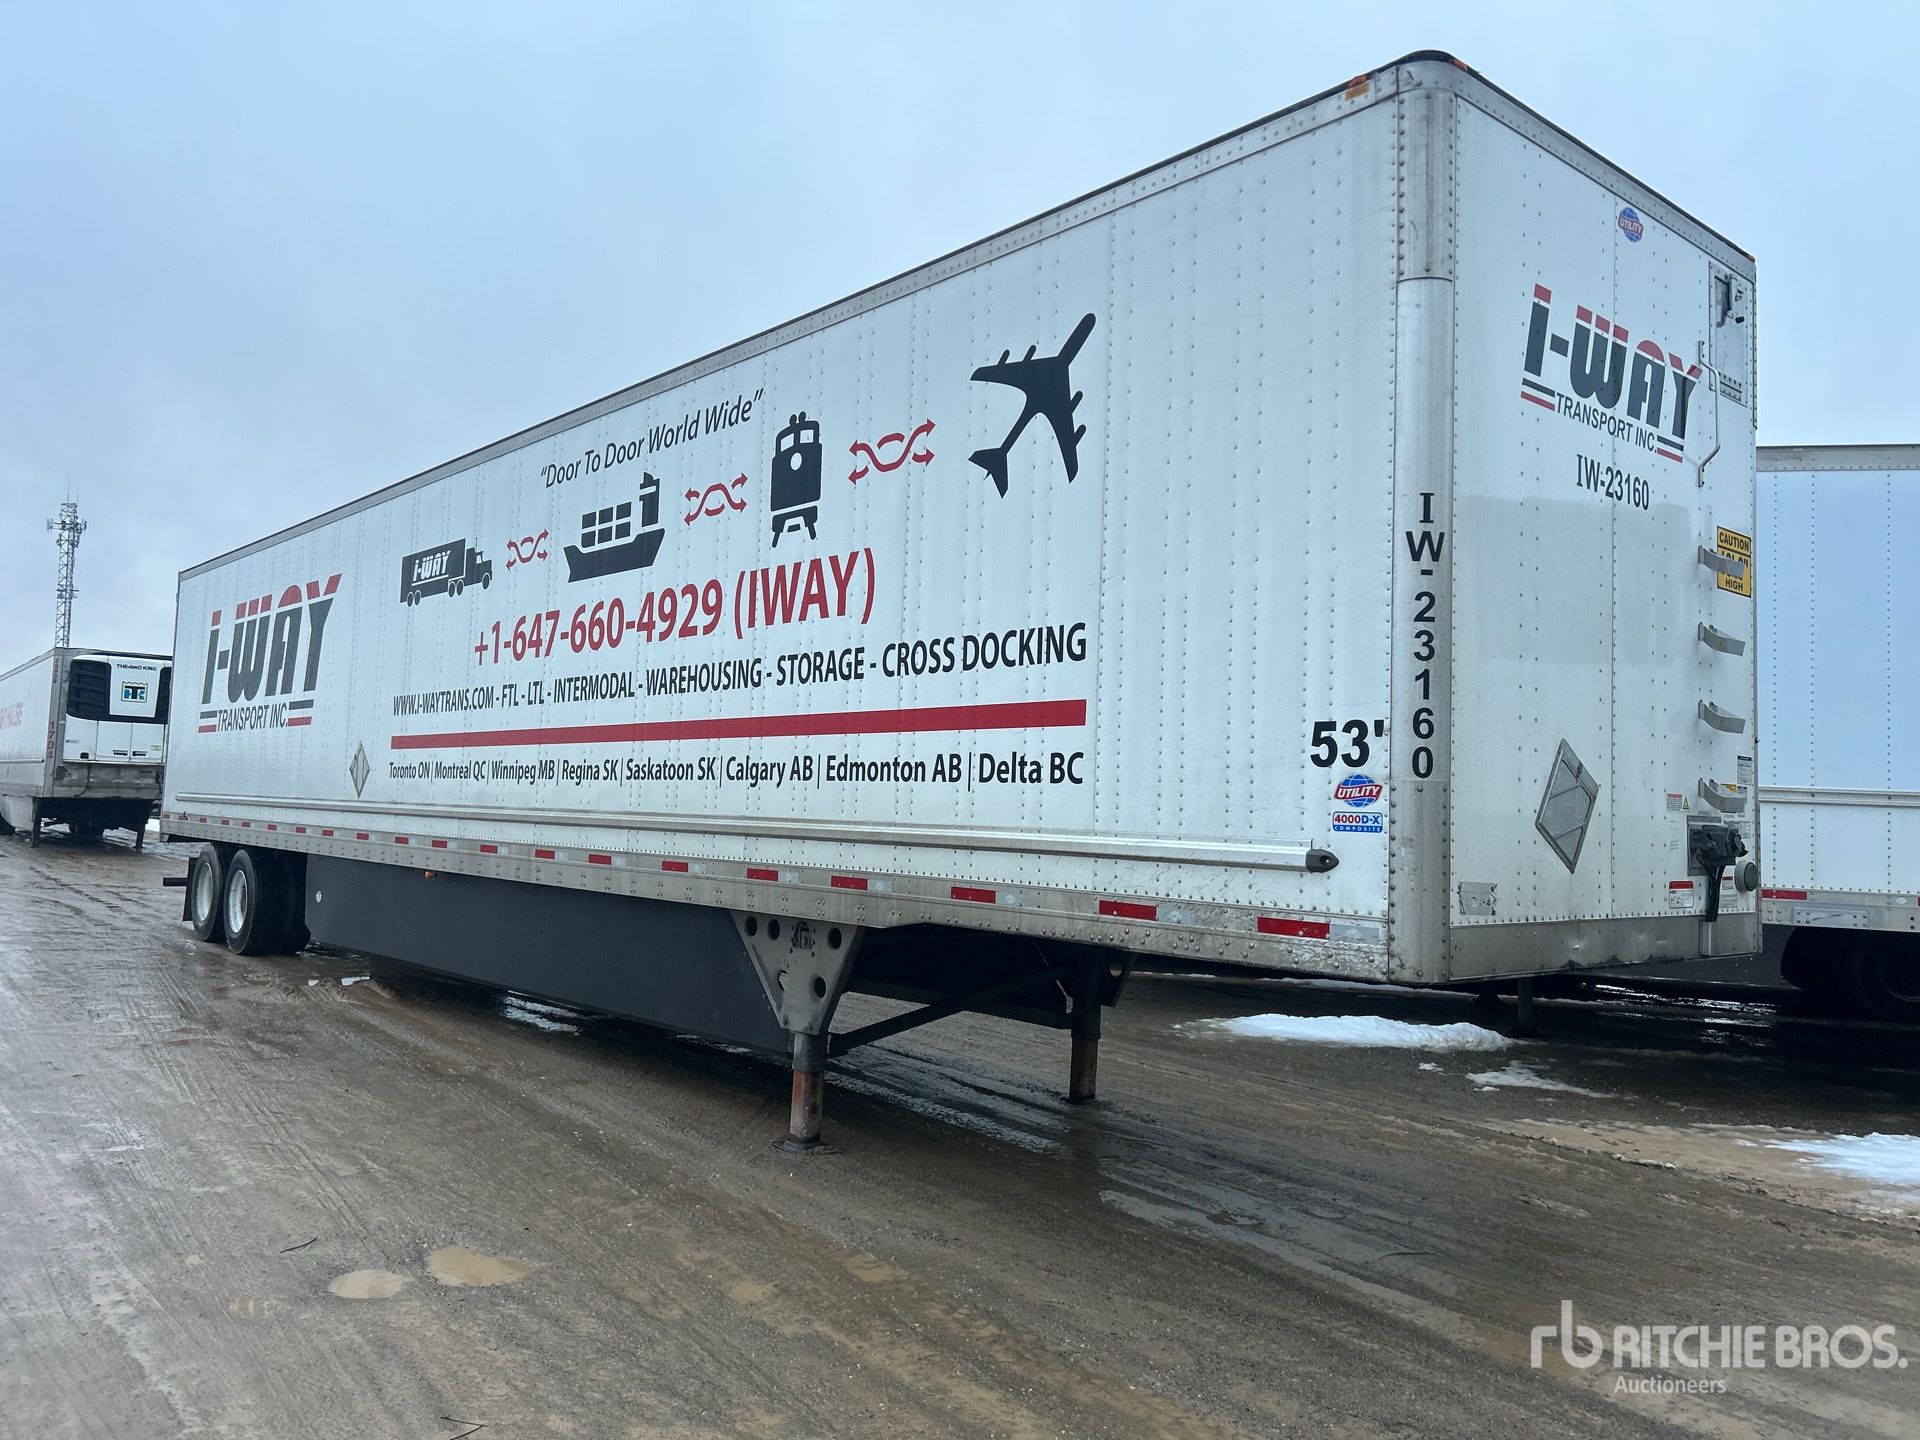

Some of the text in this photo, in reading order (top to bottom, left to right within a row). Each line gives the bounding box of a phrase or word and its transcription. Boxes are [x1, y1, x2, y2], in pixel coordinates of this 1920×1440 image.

[1619, 217, 1643, 235] UTILITY
[1556, 392, 1657, 453] TRANSPORT INC.
[585, 447, 602, 475] To
[604, 436, 645, 469] Door
[648, 410, 701, 453] World
[1577, 454, 1649, 511] IW-23160
[1719, 531, 1749, 552] CAUTION
[1725, 577, 1744, 592] HIGH
[474, 547, 876, 666] +1-647-660-4929 (IWAY)
[393, 686, 495, 716] WWW.I-WAYTRANS.COM
[501, 684, 519, 708] FTL
[527, 681, 545, 706] LTL
[553, 671, 635, 703] INTERMODAL
[646, 657, 762, 697] WAREHOUSING
[776, 646, 865, 687] STORAGE
[882, 636, 956, 678] CROSS
[962, 622, 1087, 671] DOCKING
[217, 702, 288, 732] TRANSPORT INC.
[389, 762, 417, 780] Toronto
[418, 762, 430, 779] ON
[434, 759, 471, 780] Montreal
[473, 760, 486, 781] QC
[491, 758, 537, 784] Winnipeg
[538, 759, 555, 780] MB
[562, 758, 600, 786] Regina
[603, 758, 618, 781] SK
[625, 757, 694, 781] Saskatoon
[697, 756, 716, 781] SK
[726, 755, 786, 788] Calgary
[789, 755, 813, 781] AB
[826, 754, 926, 783] Edmonton
[932, 754, 962, 783] AB
[978, 751, 1042, 784] Delta
[1050, 752, 1085, 785] BC
[1337, 786, 1380, 798] UTILITY
[1334, 814, 1380, 824] 4000D-X
